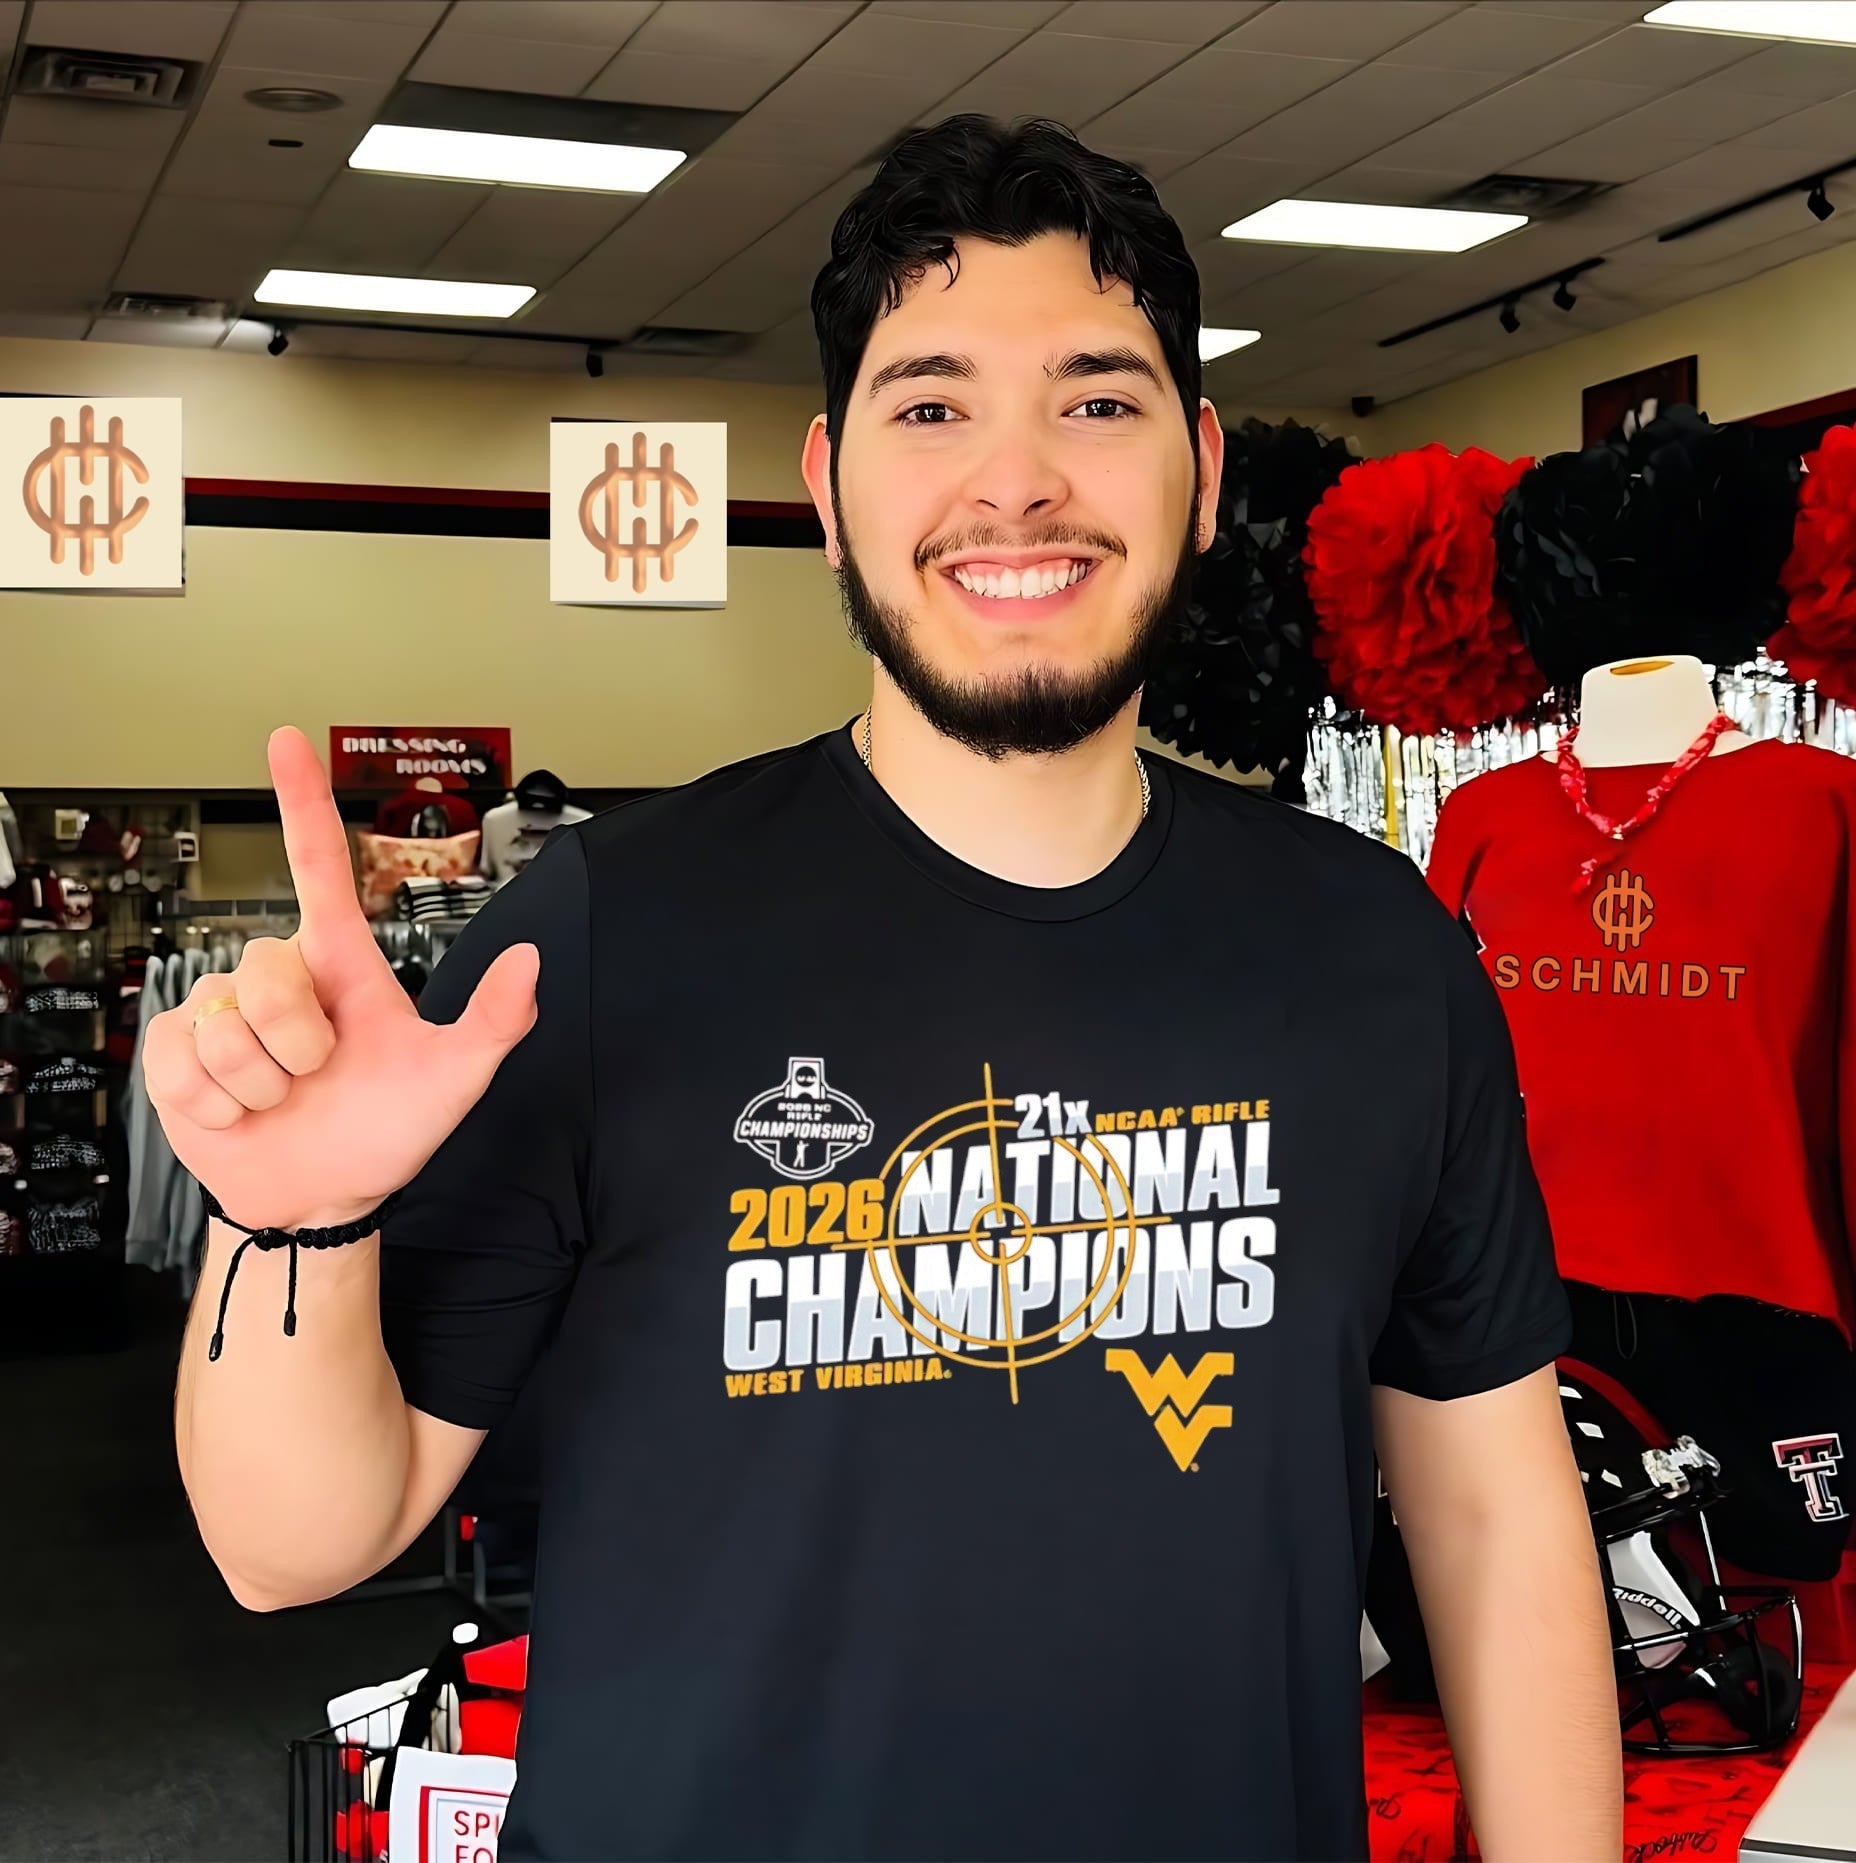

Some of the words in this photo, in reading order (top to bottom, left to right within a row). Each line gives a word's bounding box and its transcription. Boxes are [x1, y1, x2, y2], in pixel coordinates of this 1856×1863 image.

[342, 737, 467, 754] DRESSING
[396, 758, 487, 775] ROOMS
[1494, 954, 1747, 1001] SCHMIDT
[786, 1112, 822, 1121] RIFLE
[1014, 1091, 1093, 1139] 21x
[1190, 1099, 1270, 1125] RIFLE
[740, 1119, 869, 1141] CHAMPIONSHIPS
[727, 1178, 885, 1252] 2026
[898, 1120, 1280, 1236] NATIONAL
[723, 1216, 1277, 1371] CHAMPIONS
[725, 1369, 804, 1398] WEST
